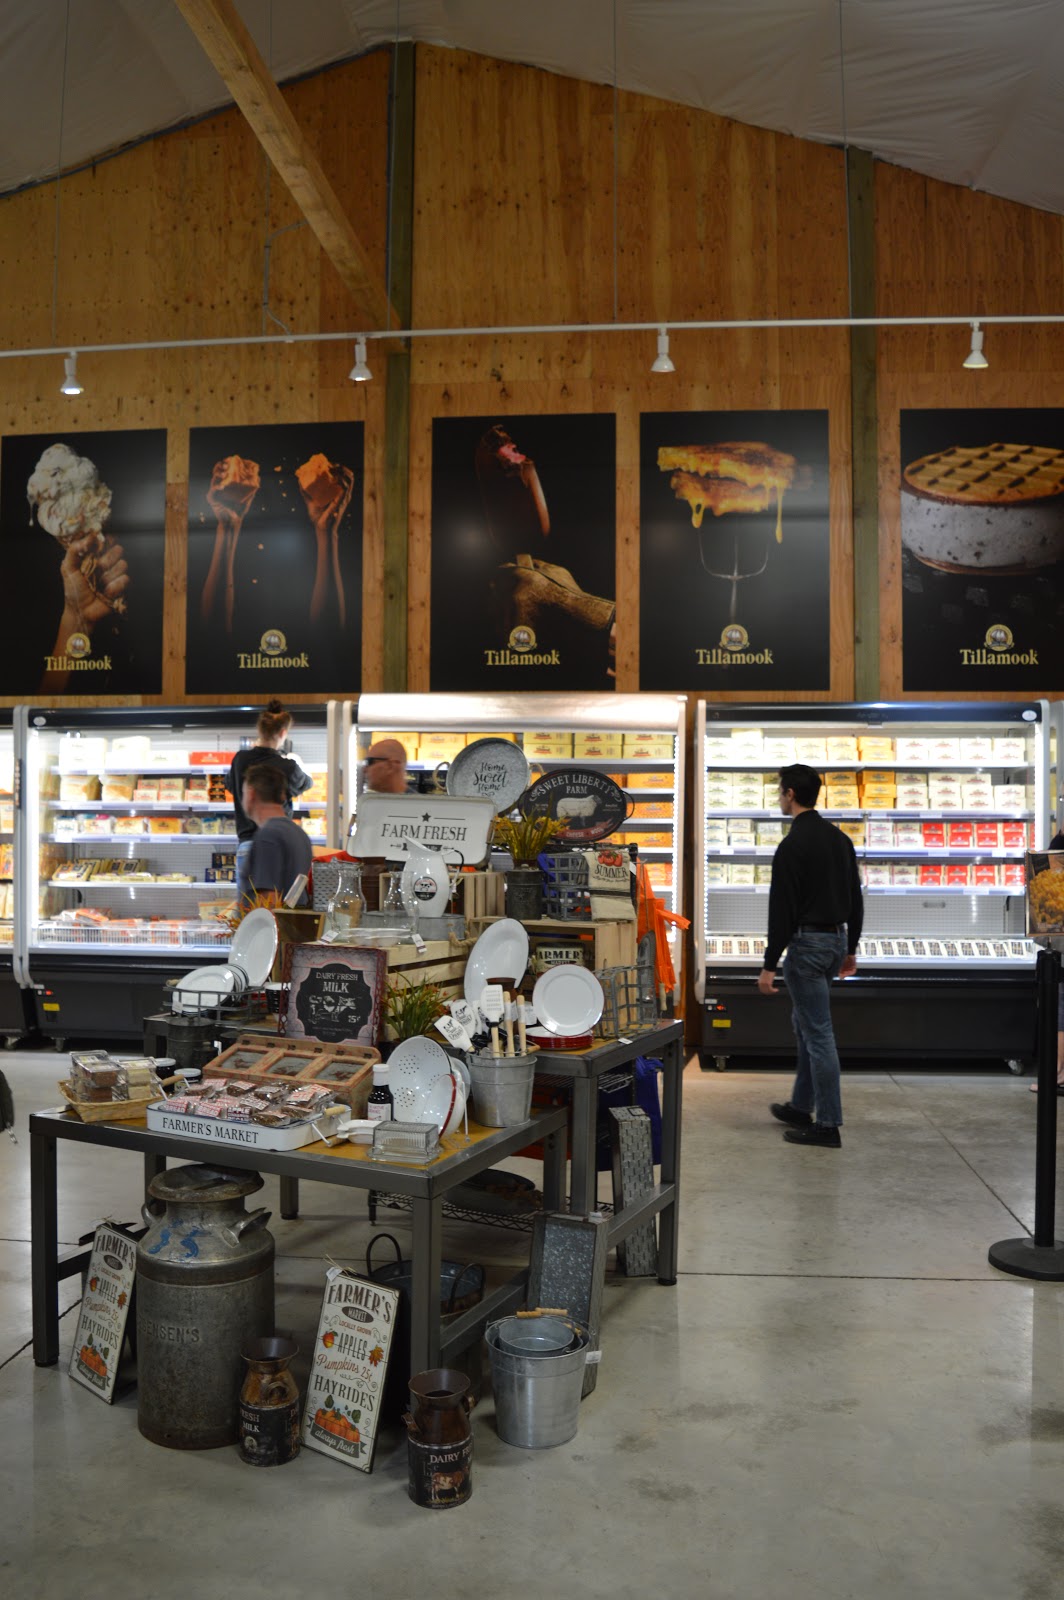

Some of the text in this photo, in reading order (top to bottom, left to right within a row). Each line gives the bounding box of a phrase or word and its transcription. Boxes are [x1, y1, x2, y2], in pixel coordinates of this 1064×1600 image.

[45, 655, 113, 671] Tillamook
[236, 653, 309, 669] Tillamook
[484, 650, 561, 665] Tillamook
[696, 649, 774, 665] Tillamook
[959, 649, 1039, 665] Tillamook
[538, 774, 610, 795] SWEET LIBERTY
[566, 785, 587, 794] FARM
[381, 823, 467, 841] FARM FRESH
[595, 864, 628, 878] SUMMER
[316, 972, 358, 980] DAIRY FRESH
[322, 981, 350, 993] MILK
[162, 1117, 259, 1144] FARMER'S MARKET
[95, 1234, 135, 1272] FARMER'S
[327, 1284, 391, 1324] FARMER'S
[348, 1307, 368, 1323] MARKET
[81, 1315, 119, 1351] HAYRIDES
[339, 1320, 371, 1335] LOCALLY GROWN
[337, 1333, 367, 1361] APPLES
[317, 1354, 359, 1376] Pumpkins
[314, 1375, 375, 1412] HAYRIDES
[240, 1407, 260, 1423] RESH
[315, 1428, 355, 1455] always fresh
[430, 1451, 461, 1464] DAIRY
